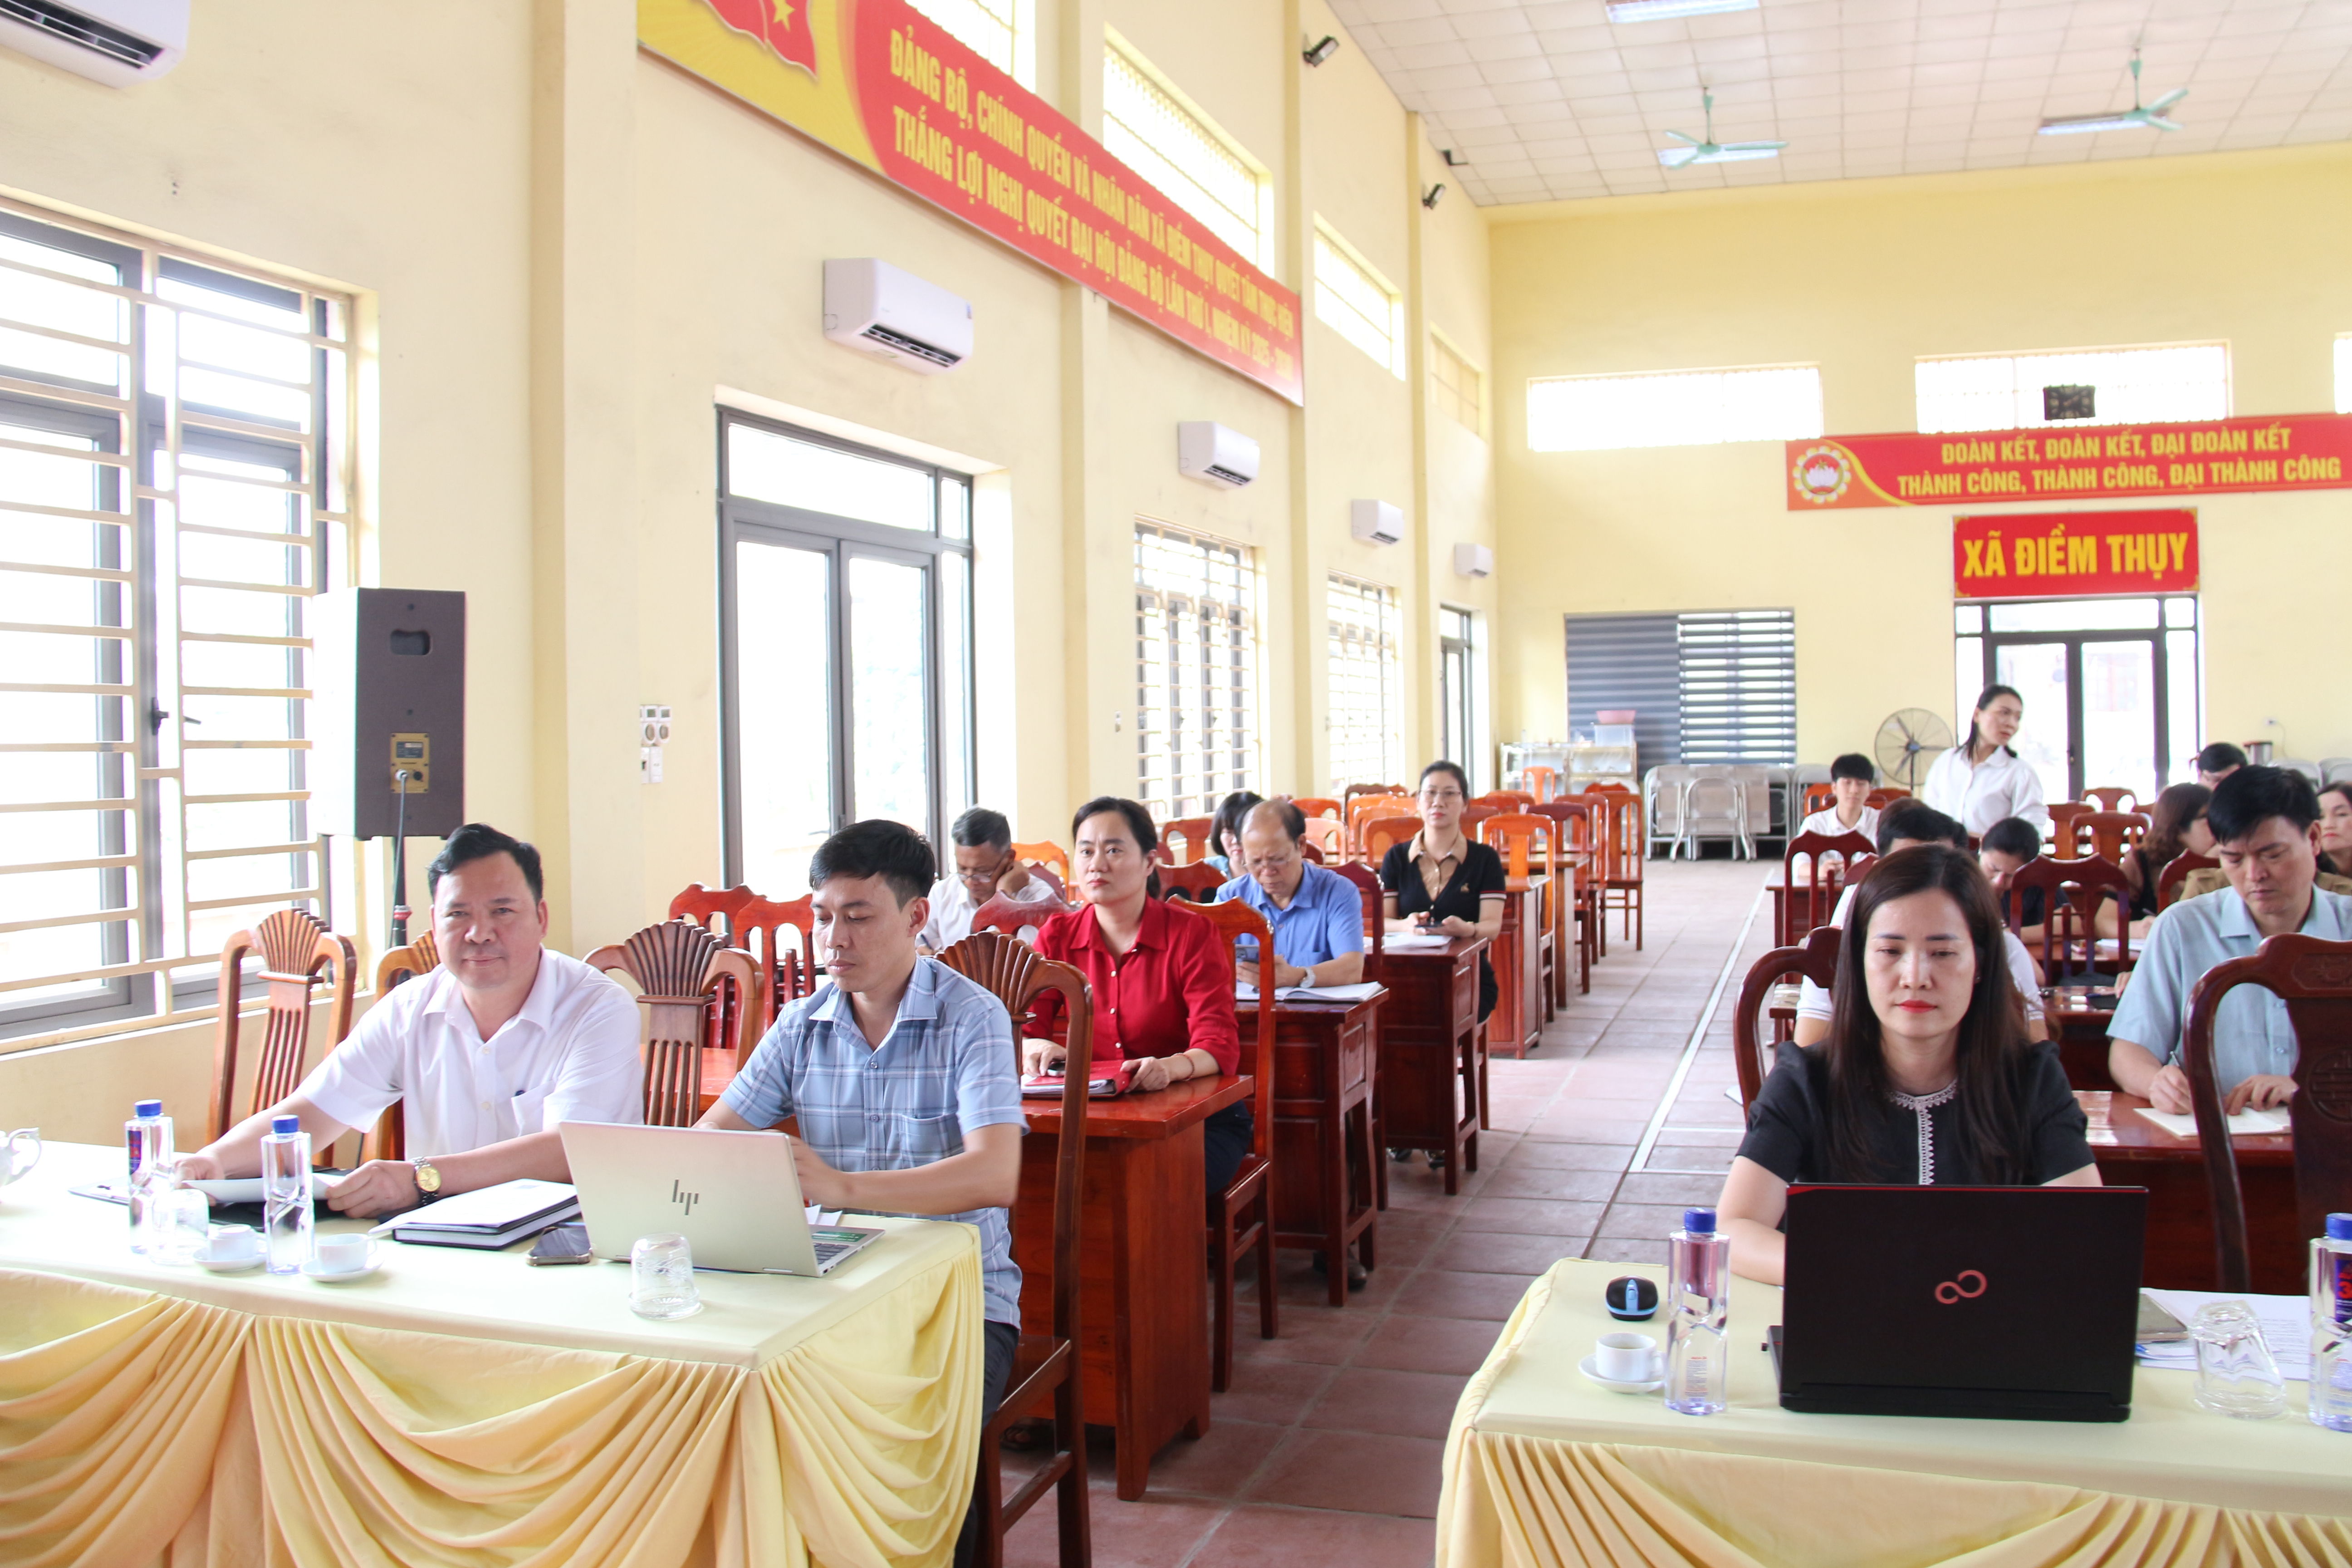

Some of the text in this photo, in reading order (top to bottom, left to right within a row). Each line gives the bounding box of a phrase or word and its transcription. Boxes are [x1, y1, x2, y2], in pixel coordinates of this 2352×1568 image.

[890, 24, 941, 103] ĐẢNG
[945, 67, 973, 129] BỘ,
[977, 90, 1024, 157] CHÍNH
[1073, 155, 1091, 201] VÀ
[1093, 169, 1126, 225] NHÂN
[1127, 194, 1150, 242] DÂN
[1151, 211, 1166, 254] XÃ
[1215, 259, 1240, 303] QUYẾT
[1241, 274, 1258, 315] TÂM
[893, 105, 952, 182] THẮNG
[957, 145, 983, 204] LỢI
[987, 163, 1023, 232] NGHỊ
[1027, 189, 1069, 248] QUYẾT
[1071, 216, 1093, 269] ĐẠI
[1095, 229, 1116, 282] HỘI
[1117, 240, 1148, 297] ĐẢNG
[1149, 264, 1164, 313] BỘ
[1166, 270, 1185, 319] LẦN
[1942, 421, 2292, 465] ĐOÀN KẾT, ĐOÀN KẾT, ĐẠI ĐOÀN KẾT
[1896, 453, 2342, 497] THÀNH CÔNG, THÀNH CÔNG, ĐẠI THÀNH CÔNG
[1962, 523, 2189, 580] XÃ ĐIỀM THỤY
[672, 1179, 700, 1216] hp
